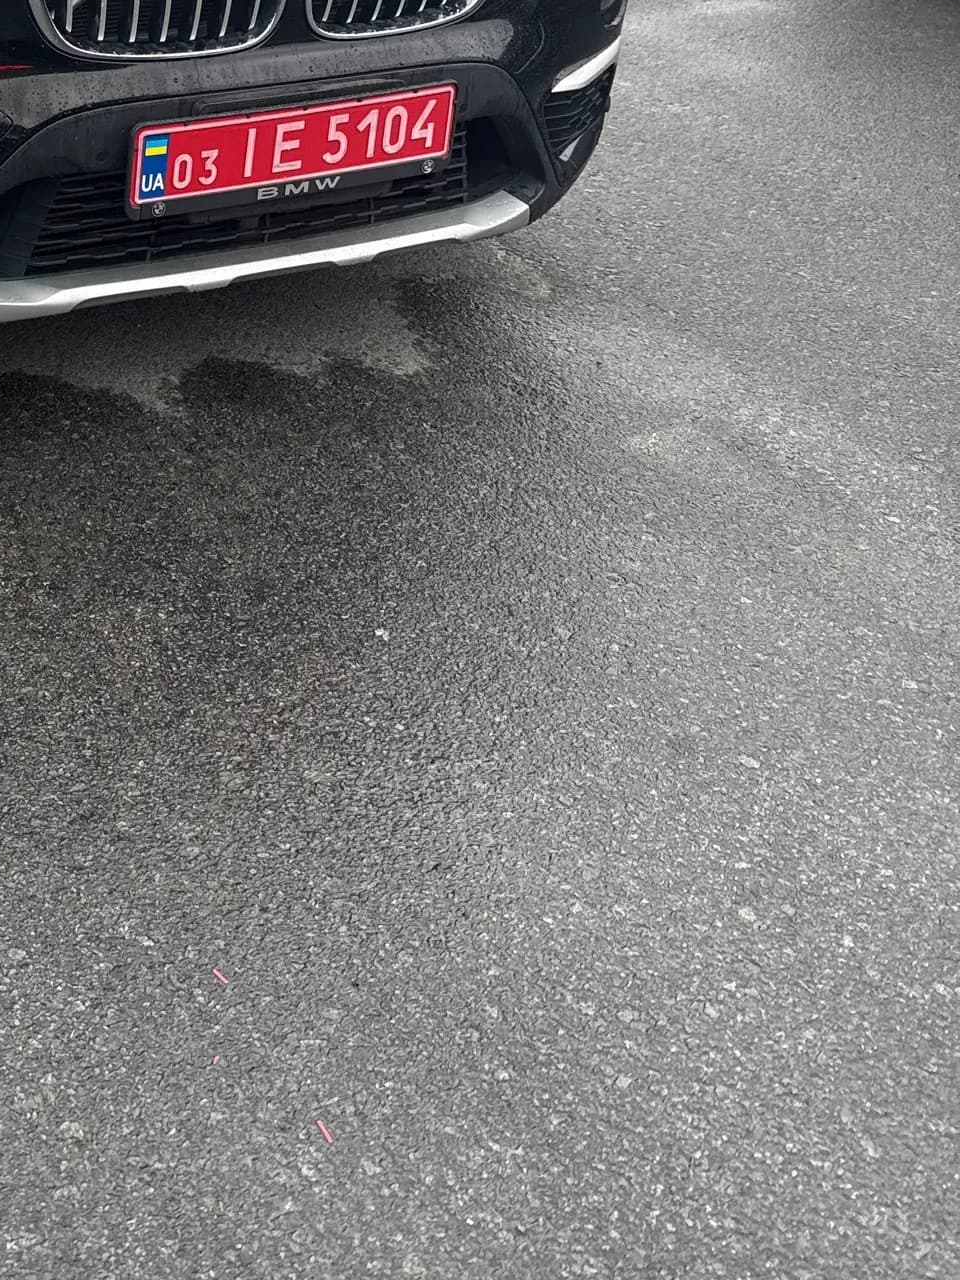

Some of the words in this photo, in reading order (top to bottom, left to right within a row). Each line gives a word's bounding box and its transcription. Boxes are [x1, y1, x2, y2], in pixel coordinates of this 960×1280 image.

[172, 148, 220, 190] 03
[243, 120, 306, 179] IE
[321, 98, 438, 165] 5104
[141, 172, 165, 192] UA
[256, 176, 341, 201] BMW
